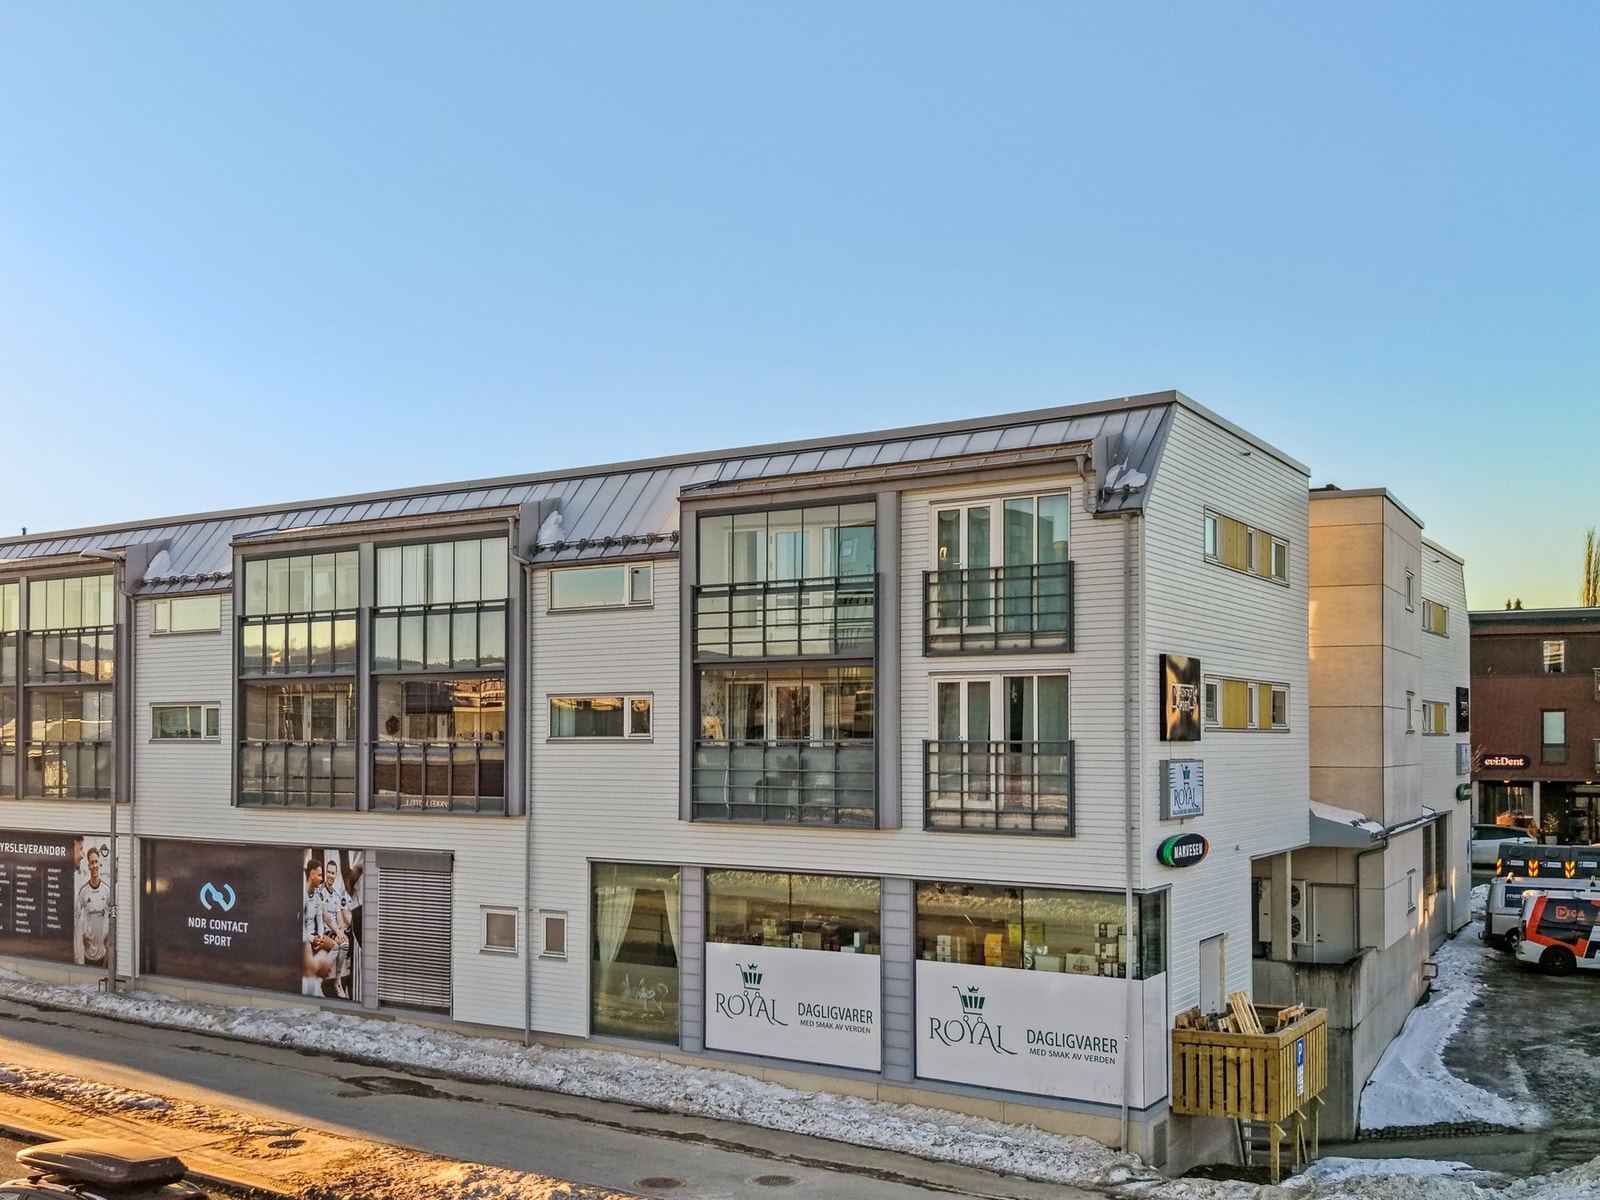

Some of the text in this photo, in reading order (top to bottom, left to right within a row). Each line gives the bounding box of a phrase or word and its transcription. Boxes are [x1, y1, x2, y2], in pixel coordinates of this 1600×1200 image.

[1484, 756, 1524, 766] evi:Dent
[1174, 786, 1199, 809] ROYAL
[1174, 842, 1203, 859] NARVESEN
[188, 917, 249, 933] NOR CONTACT
[203, 934, 232, 947] SPORT
[715, 990, 789, 1026] ROYAL
[797, 1002, 873, 1024] DAGLIGVARER
[800, 1019, 871, 1034] MED SMAK AV VERDEN
[929, 1015, 1018, 1055] ROYAL
[1026, 1029, 1118, 1054] DAGLIGVARER
[1029, 1047, 1116, 1065] MED SMAK AV VERDEN
